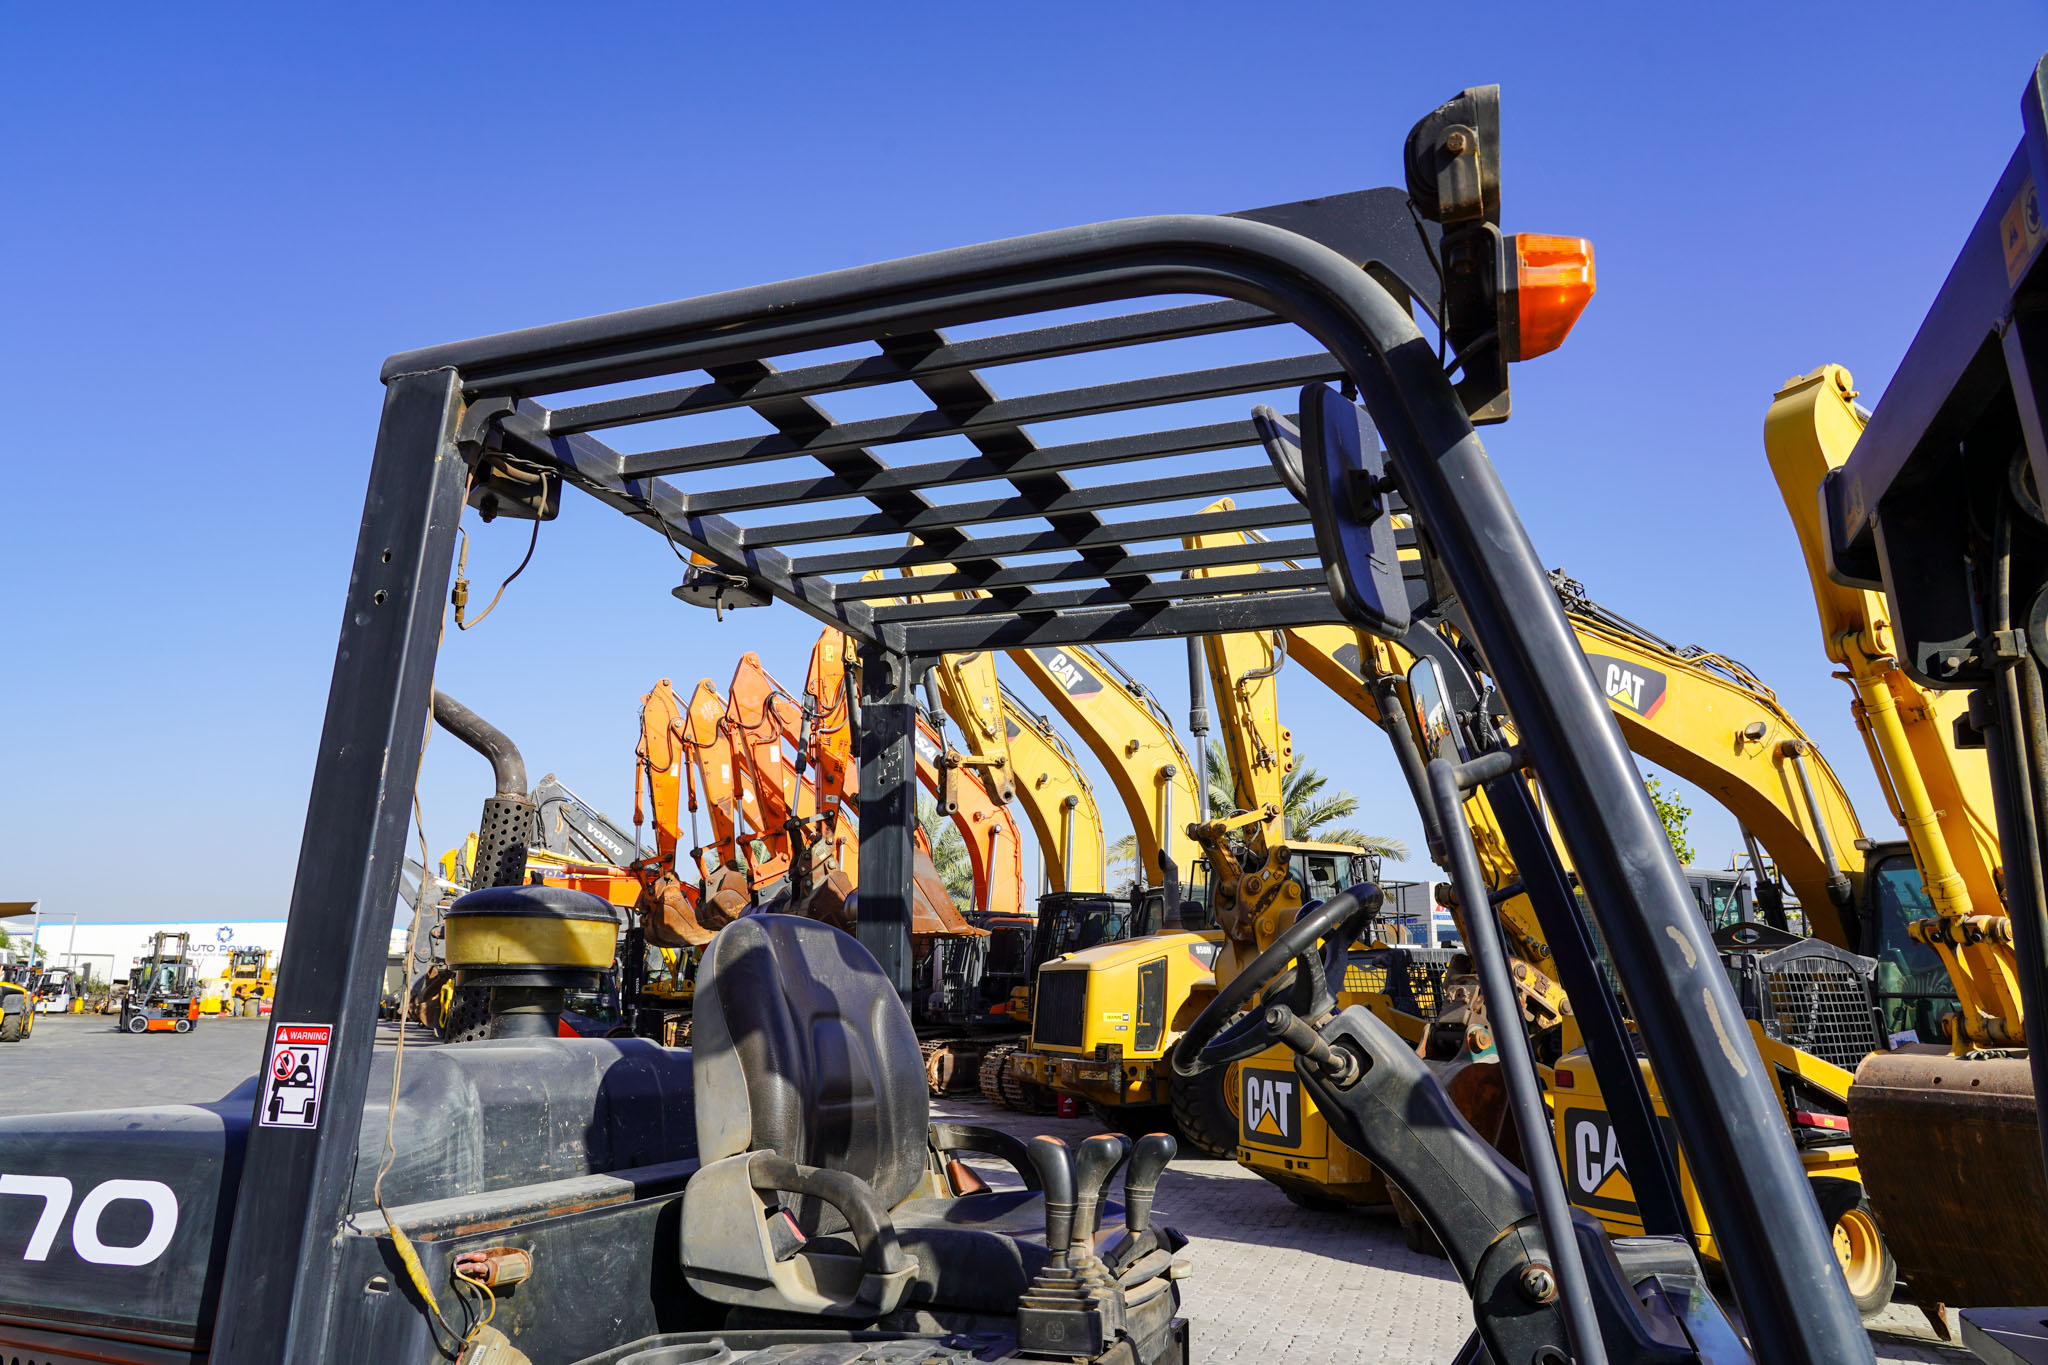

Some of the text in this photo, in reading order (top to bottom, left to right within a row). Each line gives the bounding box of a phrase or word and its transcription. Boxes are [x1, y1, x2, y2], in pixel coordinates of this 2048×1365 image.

[1049, 653, 1083, 690] CAT
[1605, 663, 1645, 710] CAT
[587, 822, 624, 856] VOLVO
[186, 944, 215, 953] AUTO
[290, 1031, 328, 1041] WARNING
[1247, 1076, 1292, 1137] CAT
[1575, 1120, 1628, 1193] CA
[0, 1174, 178, 1267] 70
